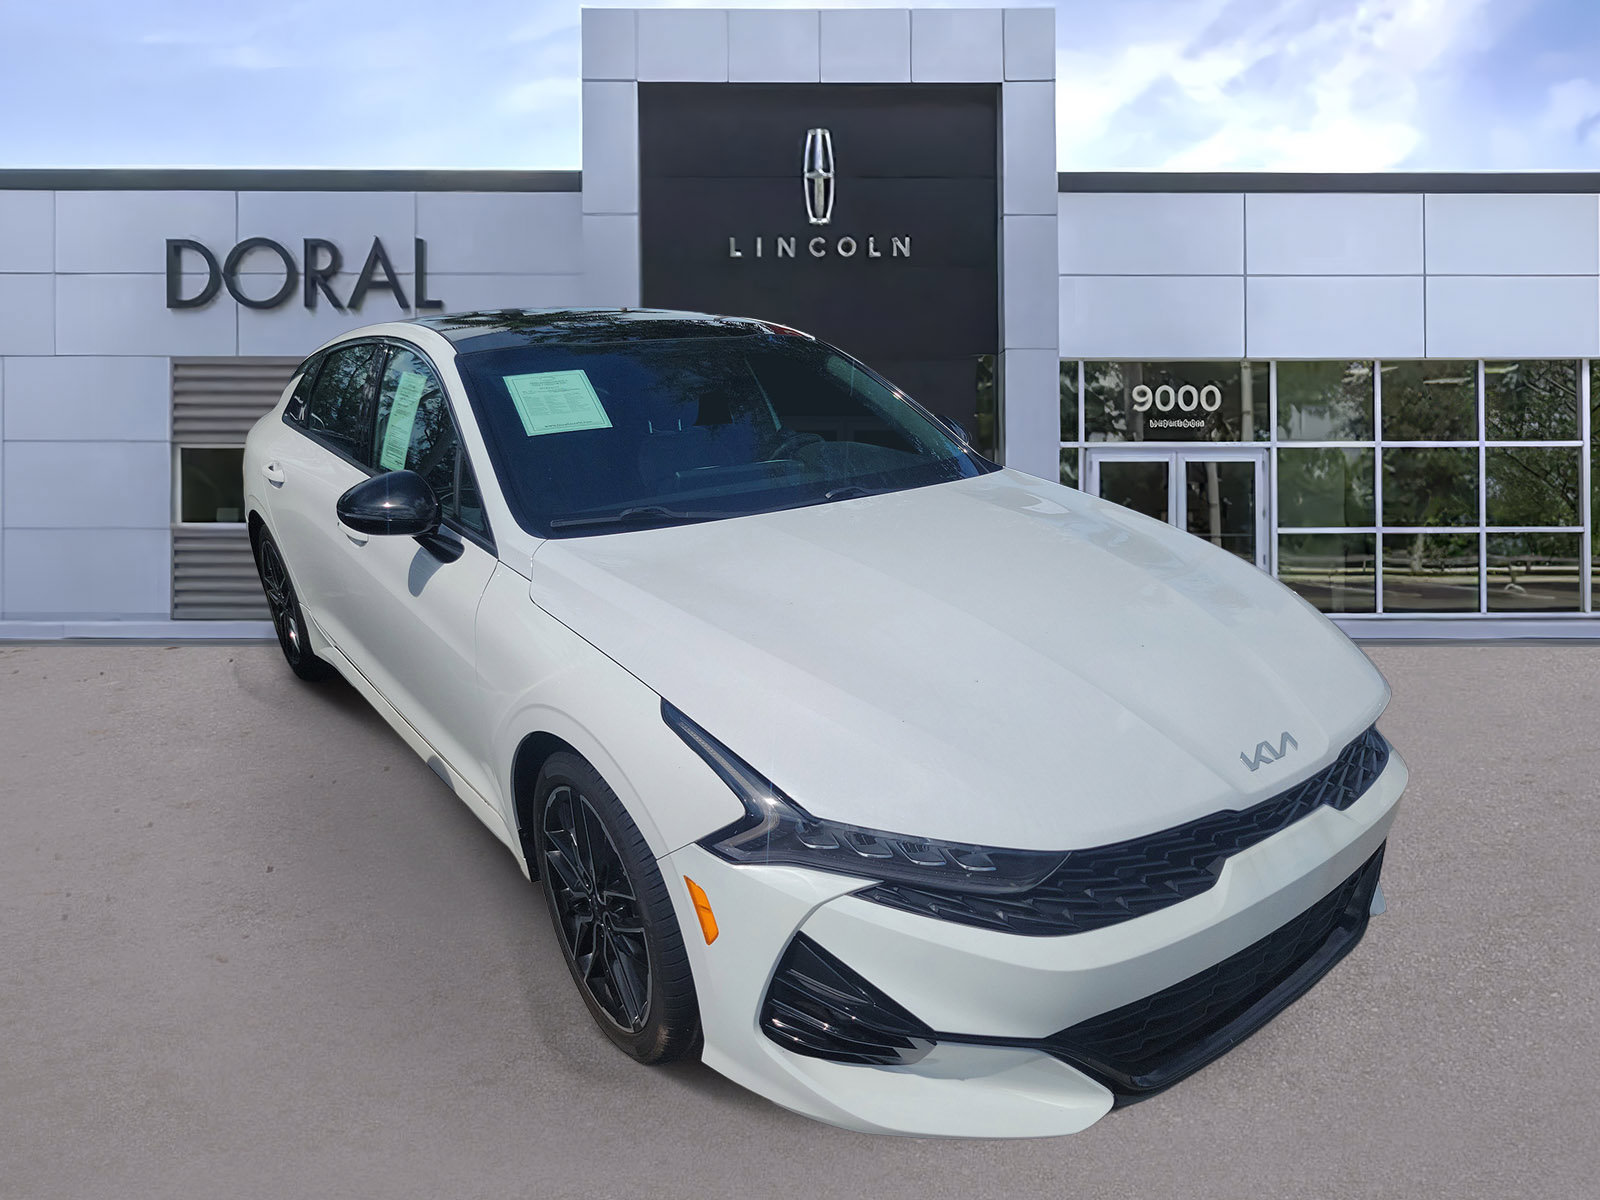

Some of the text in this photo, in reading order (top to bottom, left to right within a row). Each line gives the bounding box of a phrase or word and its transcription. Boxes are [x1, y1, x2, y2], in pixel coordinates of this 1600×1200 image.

[729, 236, 911, 258] LINCOLN
[166, 236, 443, 310] DORAL
[1131, 384, 1222, 412] 9000
[1240, 731, 1298, 772] KIA
